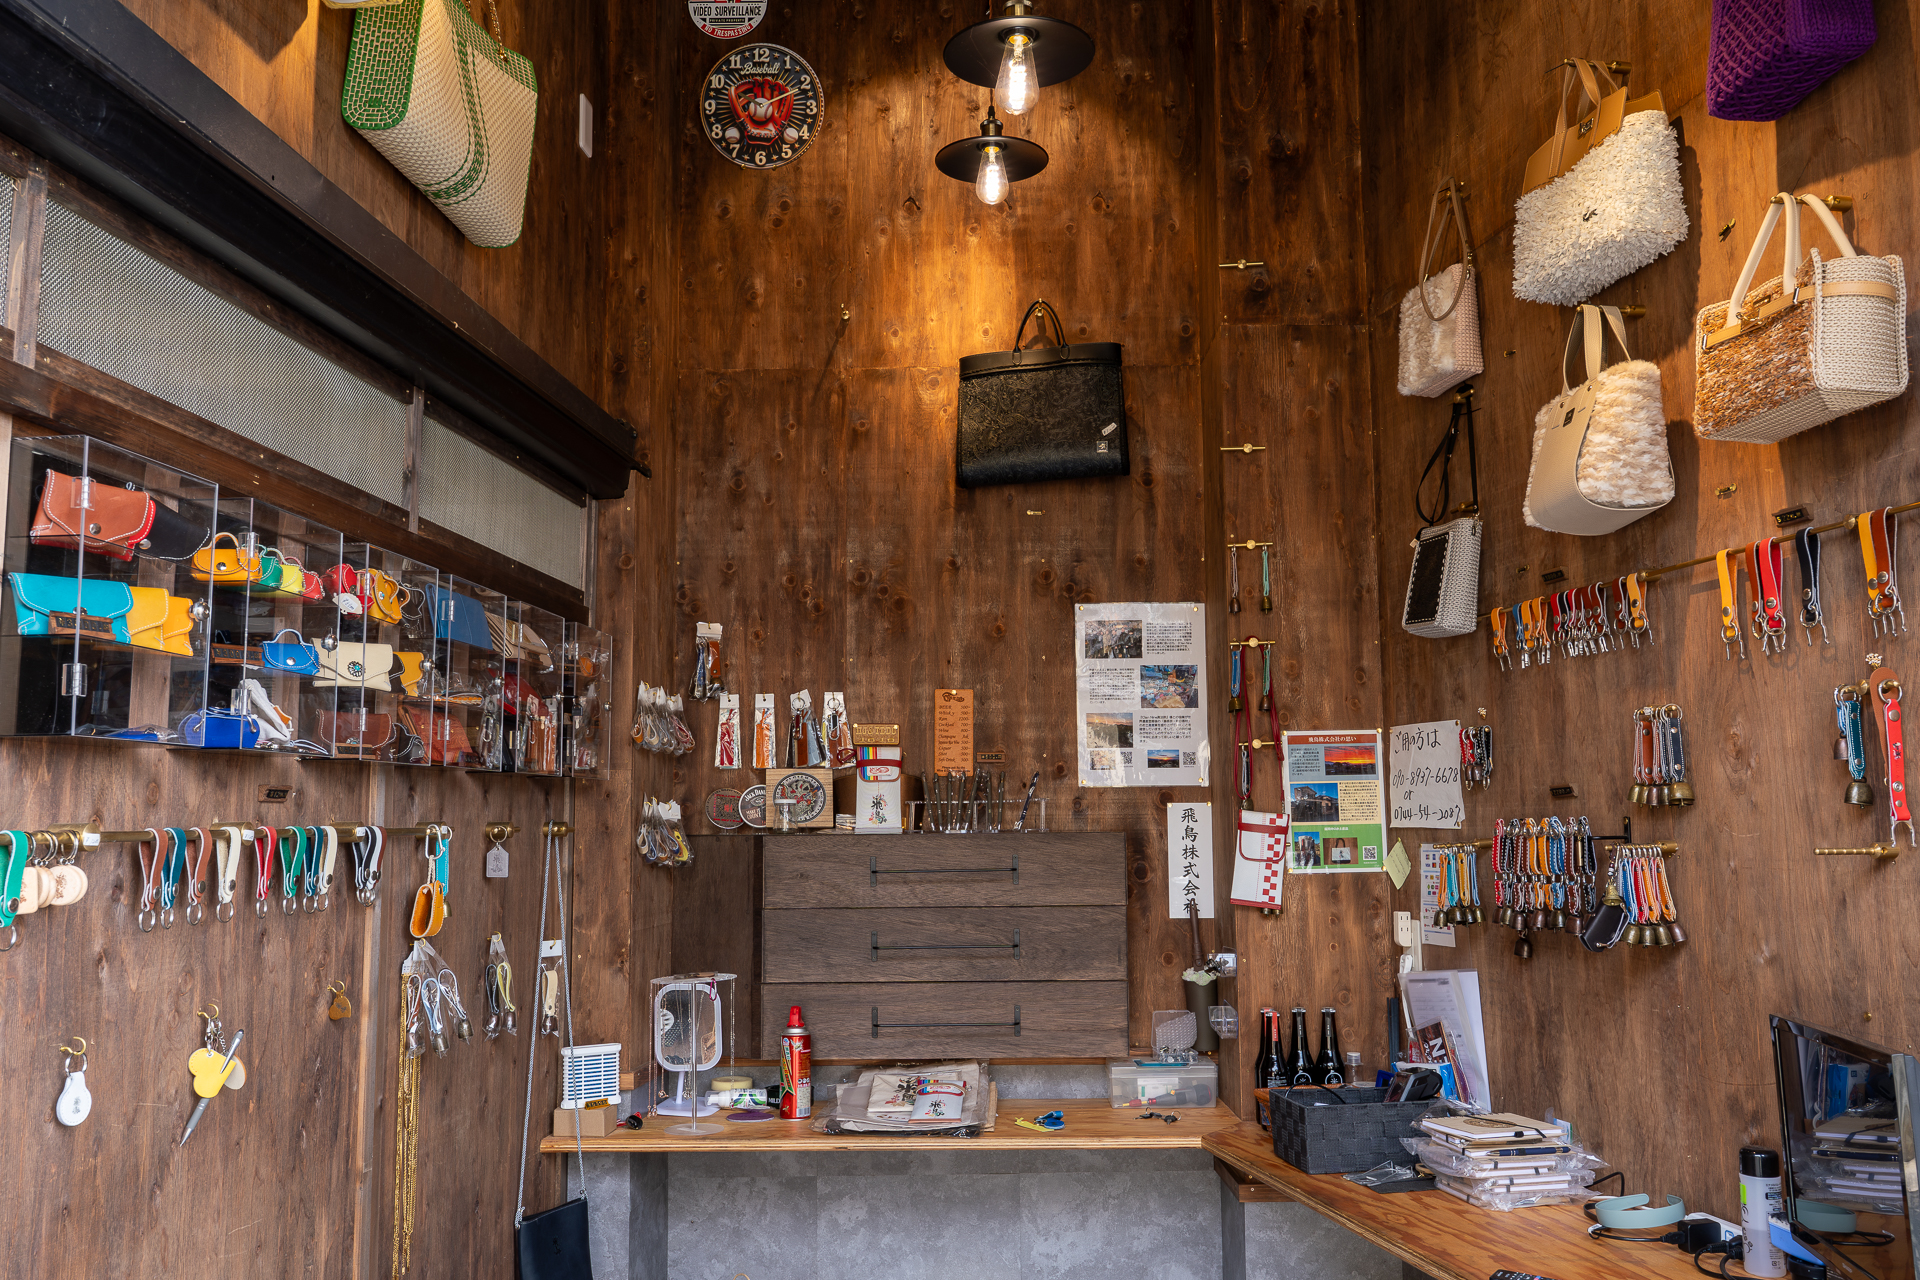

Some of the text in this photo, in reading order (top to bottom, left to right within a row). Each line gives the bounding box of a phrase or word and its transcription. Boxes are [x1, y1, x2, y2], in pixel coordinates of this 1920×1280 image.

[693, 6, 762, 16] VIDEO SURVEILLANCE
[704, 25, 751, 37] NO TRESPASSING
[729, 55, 741, 69] 11
[753, 48, 770, 62] 12
[784, 55, 791, 69] 1
[740, 62, 780, 75] Baseball
[710, 74, 725, 89] 10
[801, 75, 811, 90] 2
[704, 100, 716, 115] 9
[806, 100, 817, 115] 3
[711, 124, 722, 139] 8
[799, 125, 809, 140] 4
[729, 144, 740, 158] 7
[755, 151, 766, 166] 6
[781, 144, 792, 159] 5
[1395, 727, 1441, 754] ご用の方は
[1392, 767, 1459, 788] 090-8937-6678
[1404, 790, 1415, 800] or
[1394, 804, 1461, 826] 0744-54-2087
